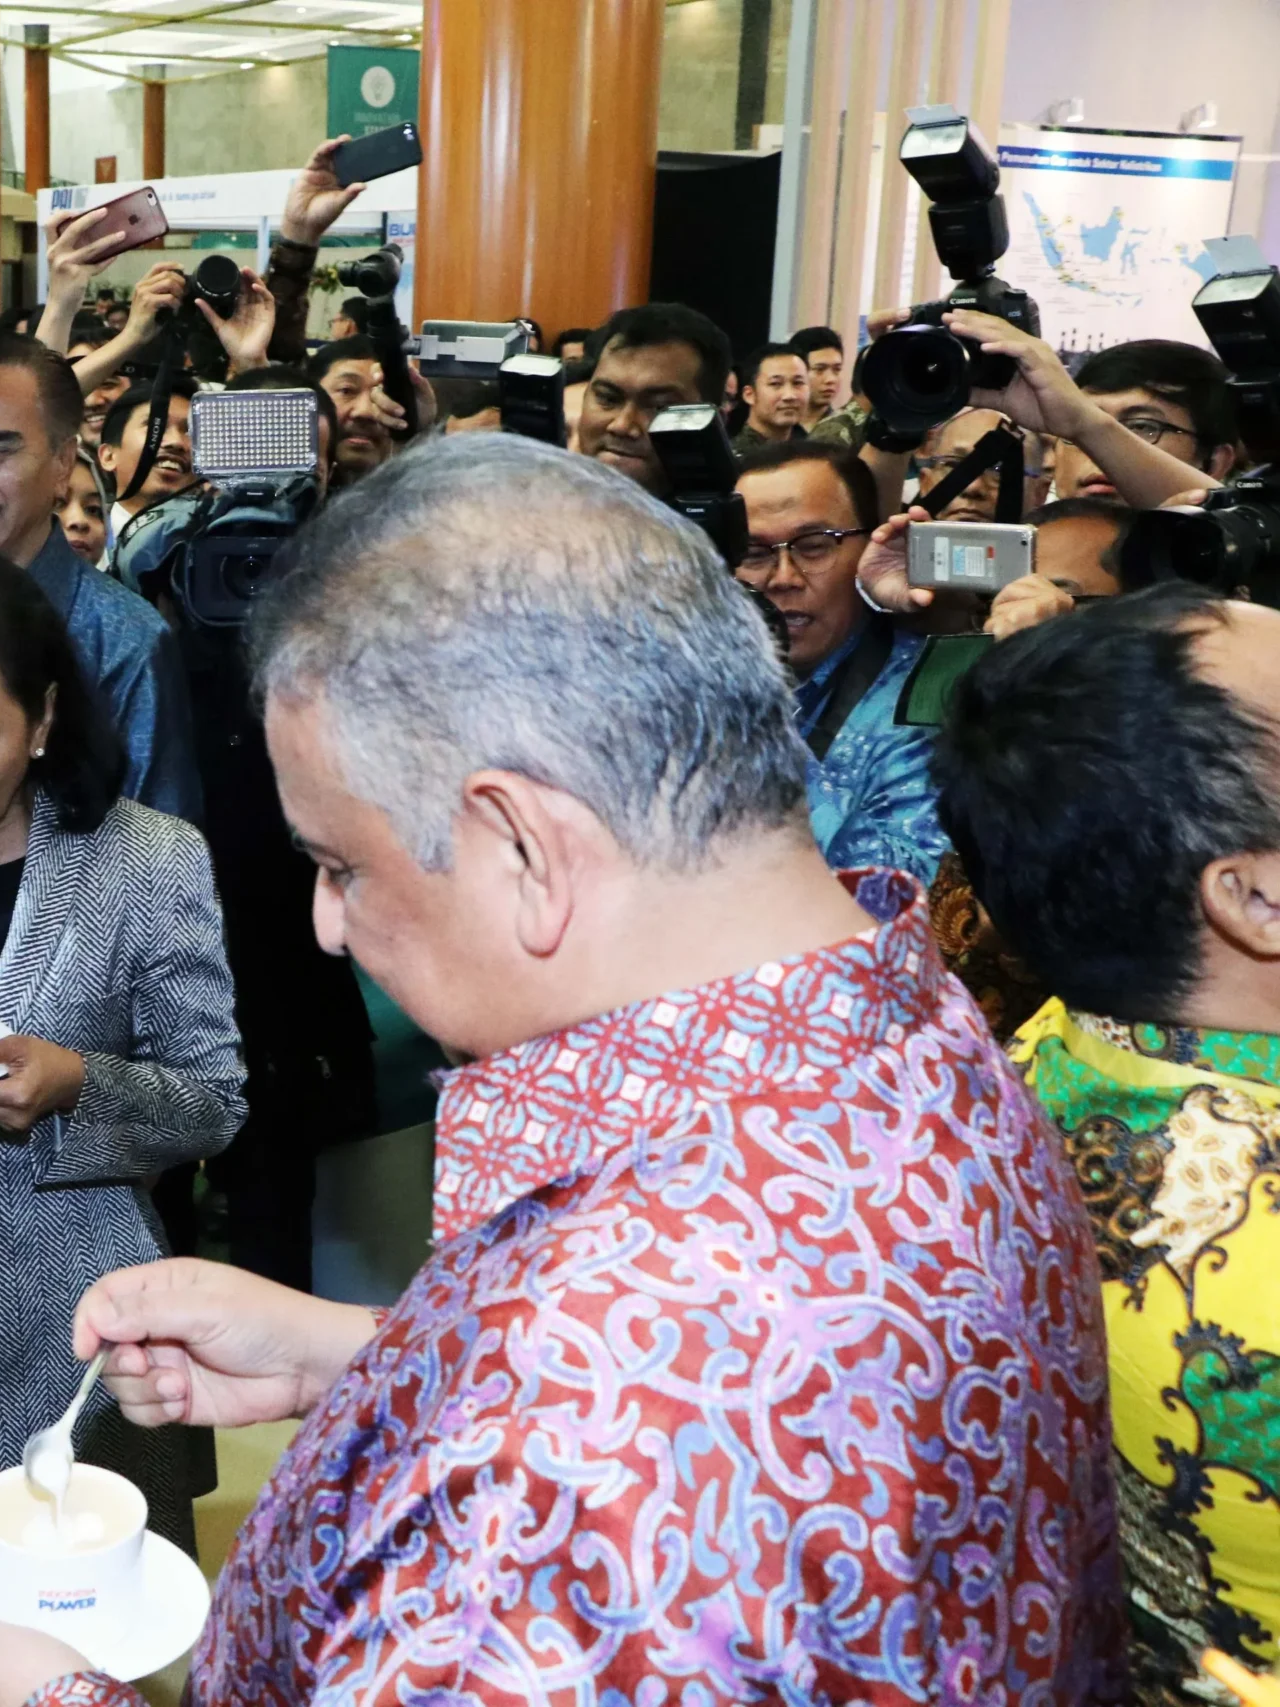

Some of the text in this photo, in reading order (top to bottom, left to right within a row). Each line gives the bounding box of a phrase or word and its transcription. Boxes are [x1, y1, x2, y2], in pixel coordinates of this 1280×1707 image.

[149, 417, 162, 450] SONY
[1236, 481, 1263, 489] Canon
[38, 1597, 96, 1610] POWER
